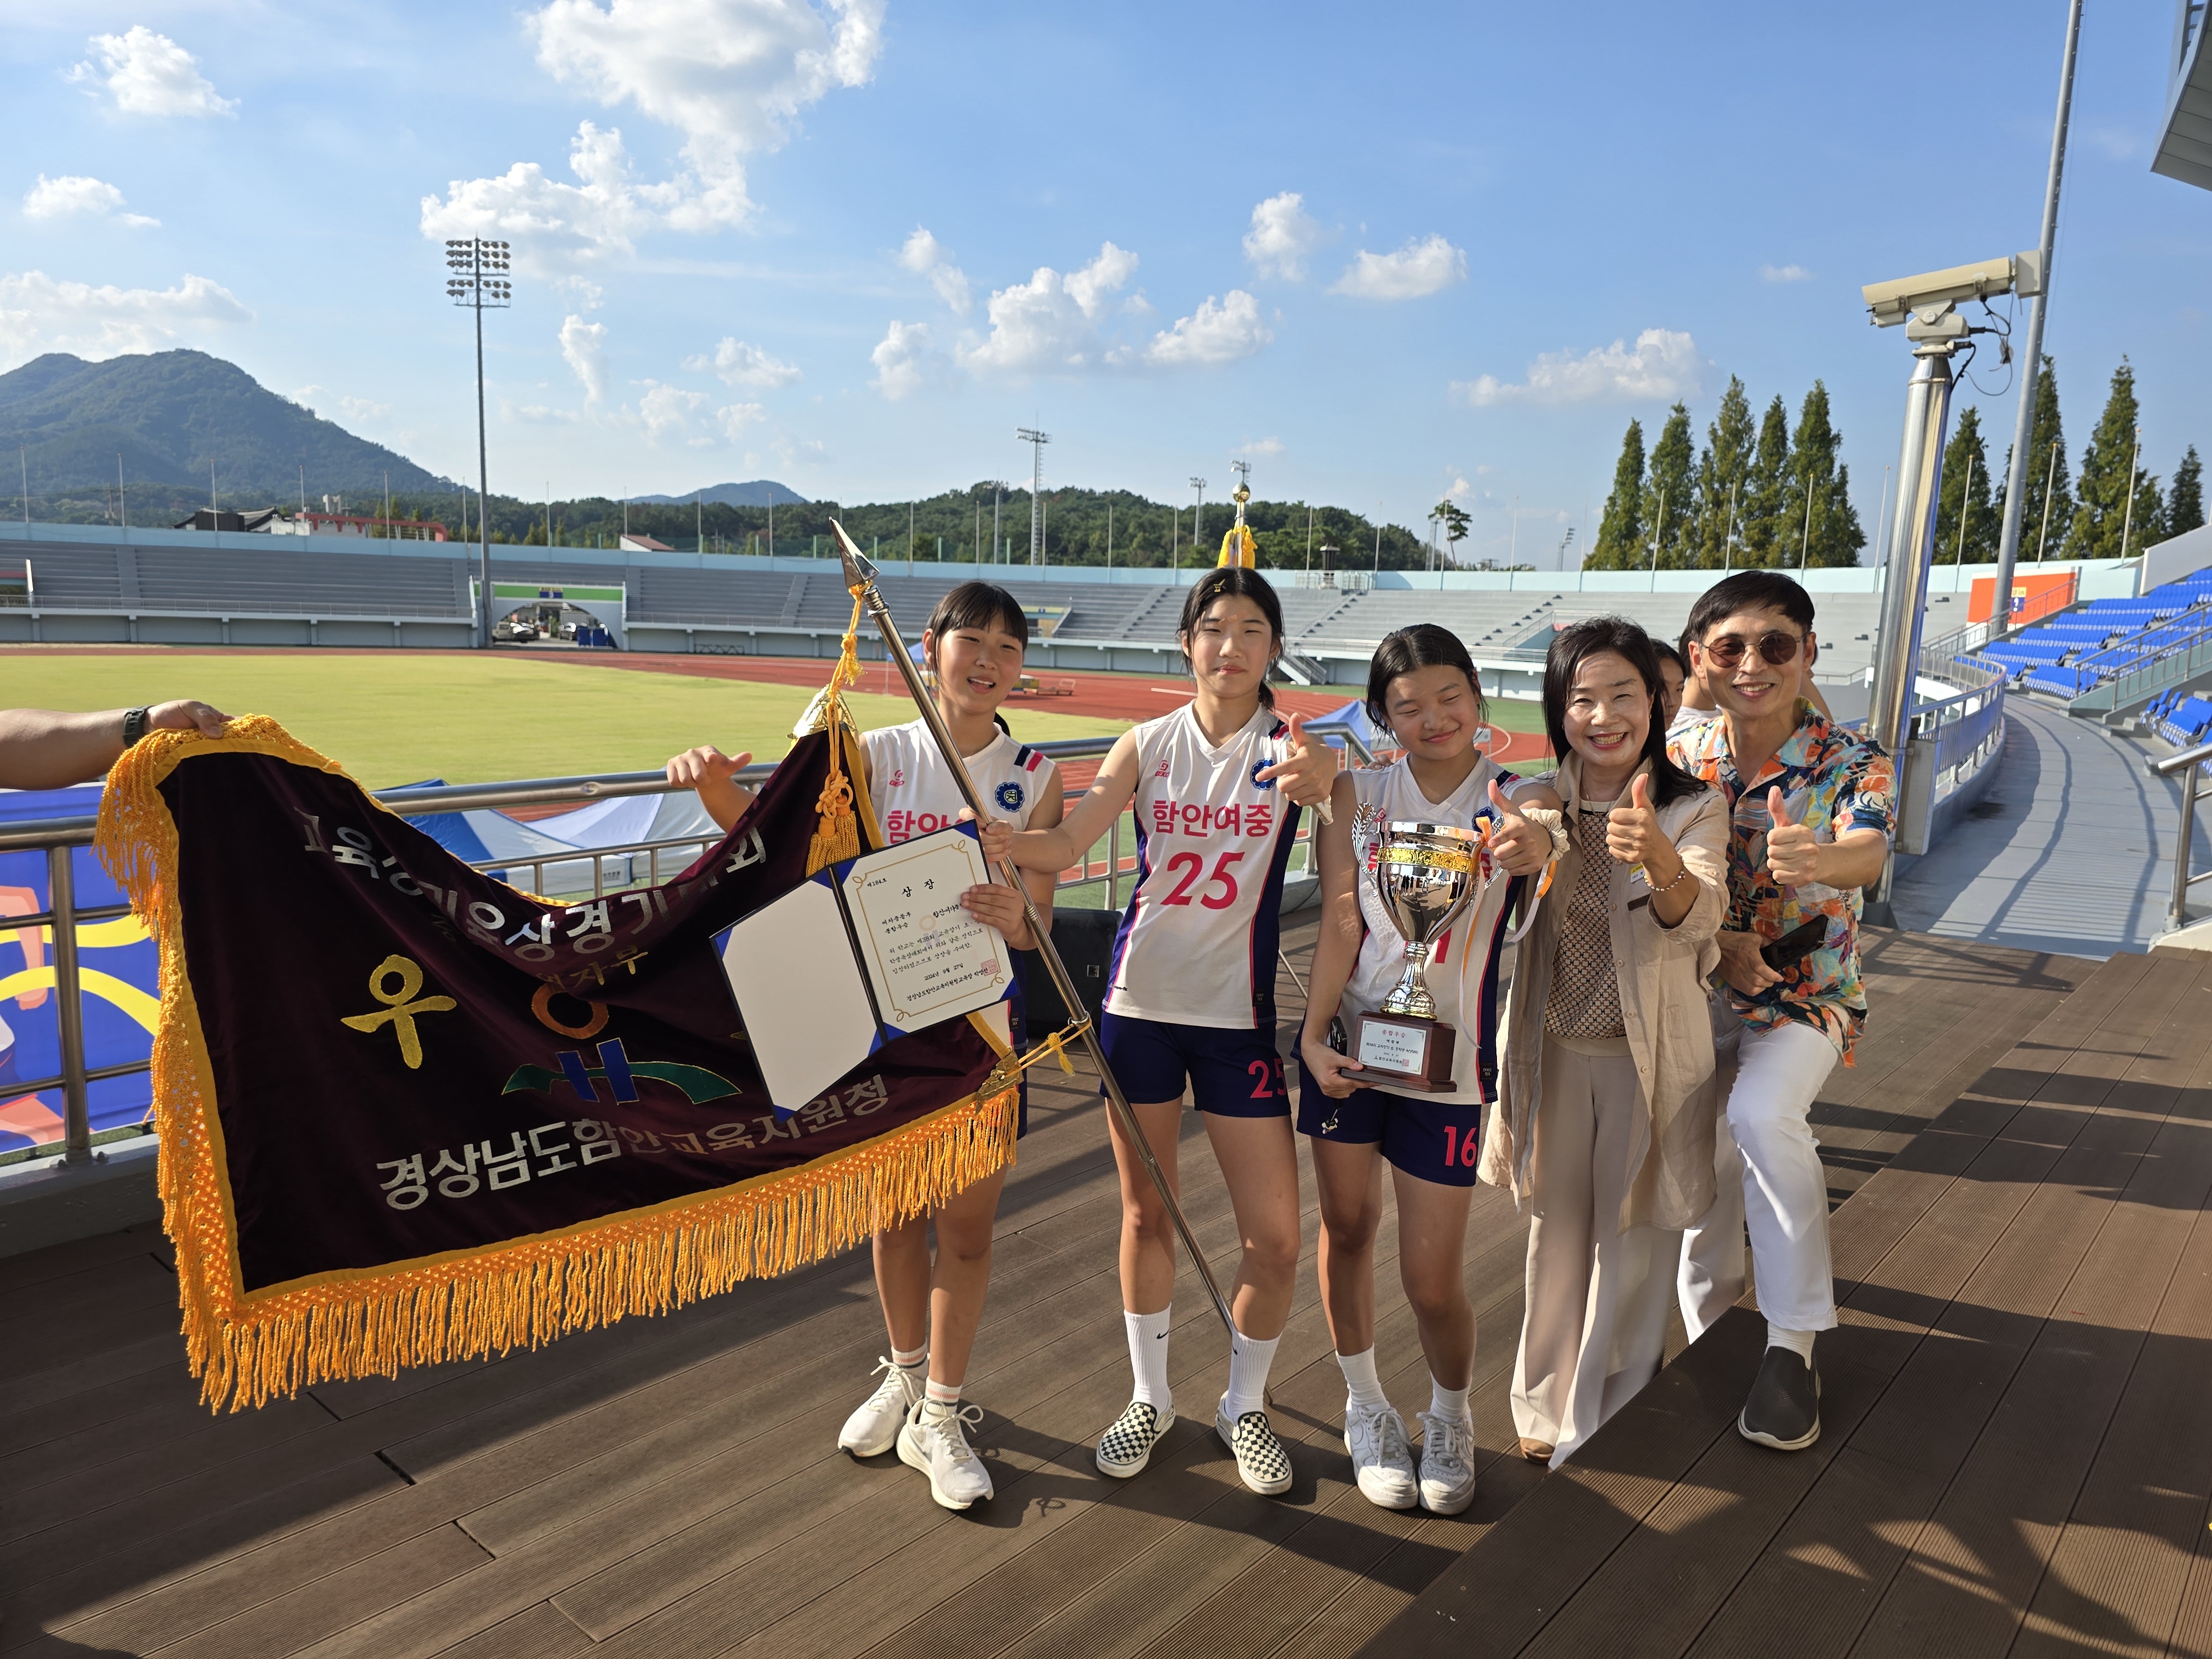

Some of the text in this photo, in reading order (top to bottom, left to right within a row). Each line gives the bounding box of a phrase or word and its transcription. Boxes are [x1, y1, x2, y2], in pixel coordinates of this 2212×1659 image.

[1153, 800, 1273, 837] 함안여중
[1160, 852, 1245, 910] 25
[933, 902, 963, 918] 함안여자중
[1248, 1058, 1288, 1099] 25
[1444, 1125, 1477, 1167] 16
